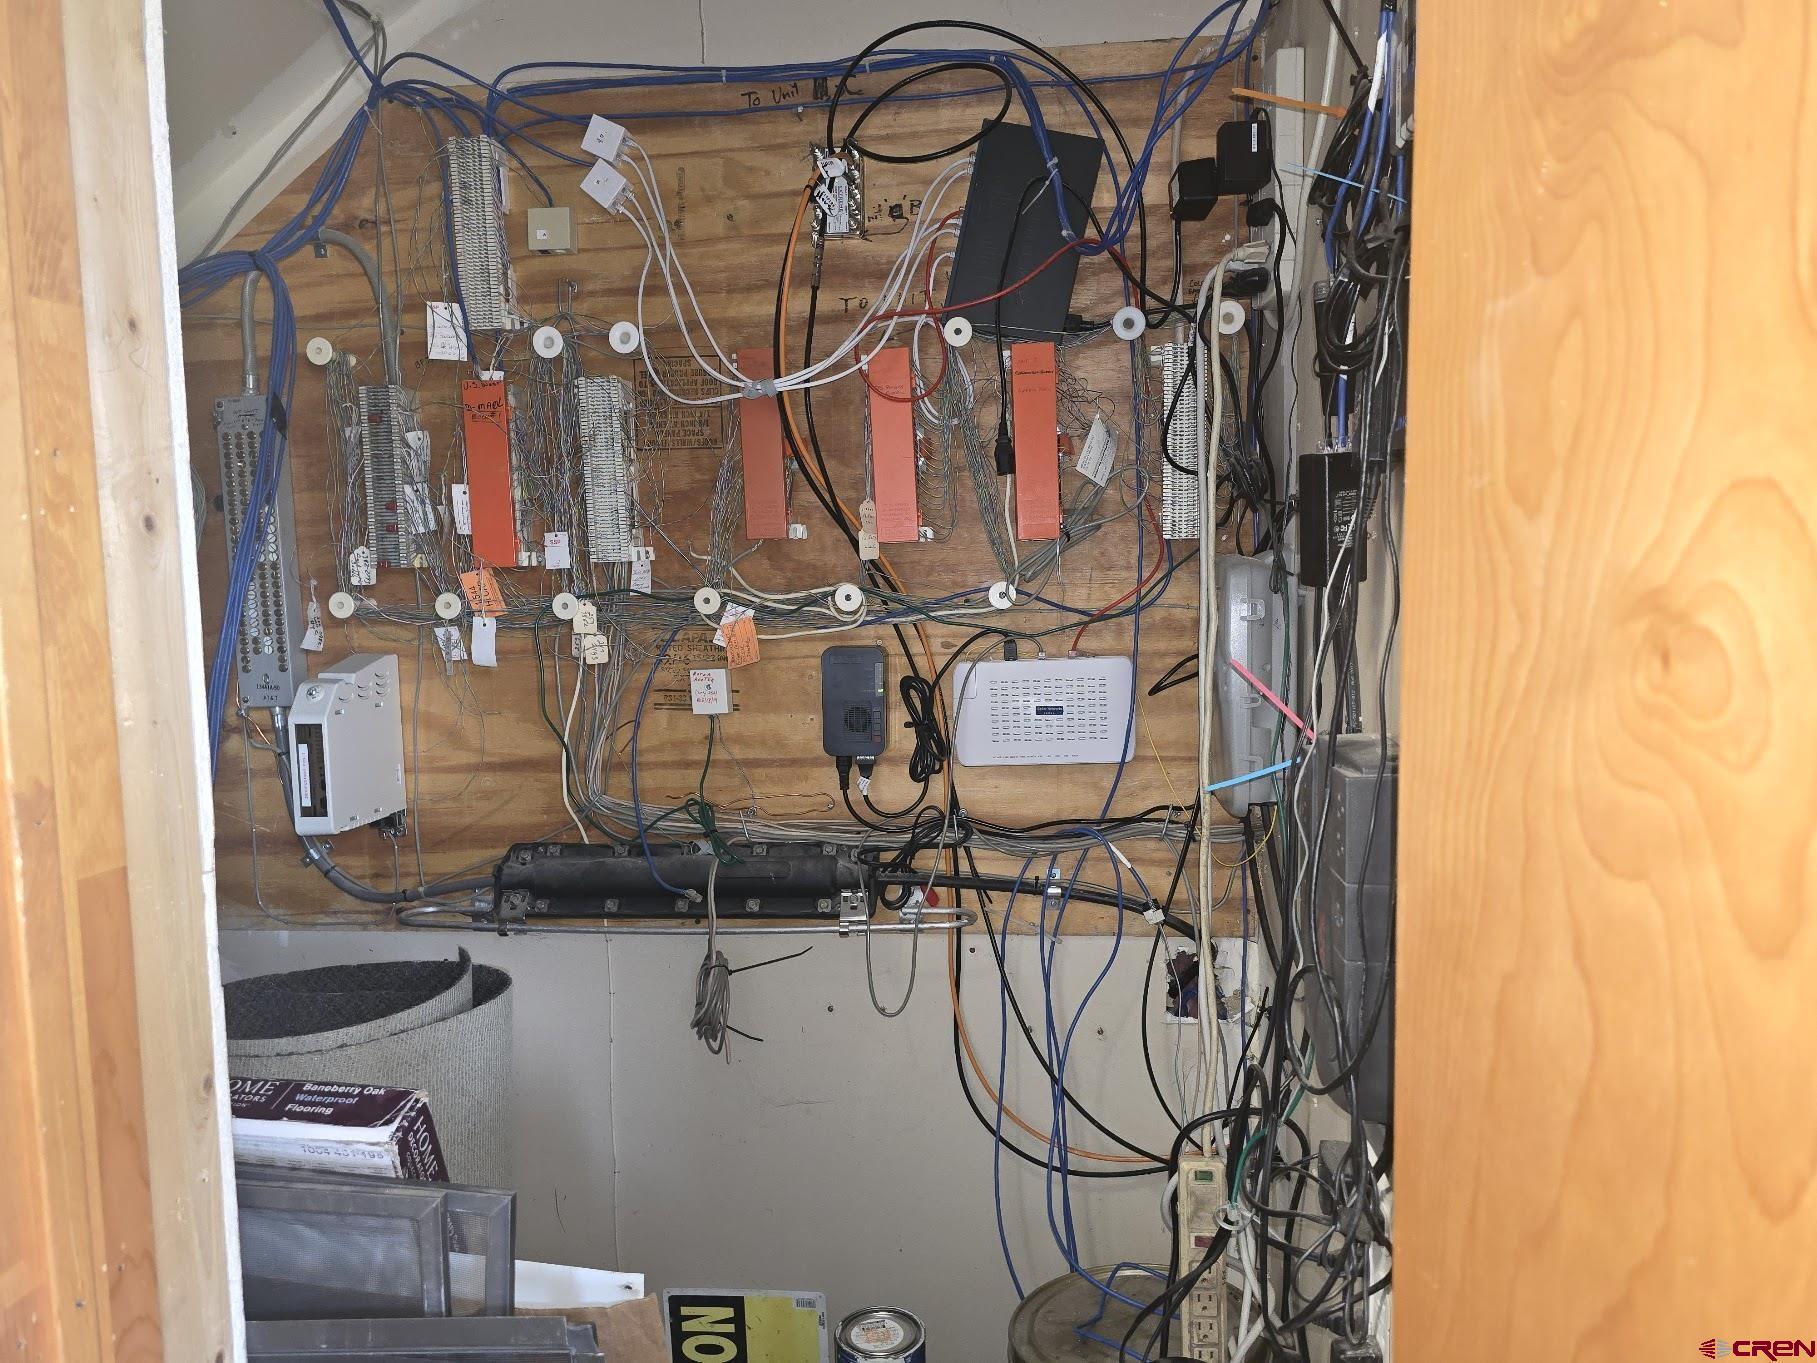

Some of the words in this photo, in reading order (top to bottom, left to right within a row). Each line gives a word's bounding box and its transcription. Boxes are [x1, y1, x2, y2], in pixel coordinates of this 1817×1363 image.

[741, 91, 760, 108] To
[772, 81, 799, 104] Unit
[838, 296, 868, 313] TO
[303, 1083, 361, 1095] Baneberry
[363, 1087, 386, 1095] Oak
[295, 1093, 359, 1104] Waterproof
[285, 1103, 334, 1115] Flooring
[413, 1115, 438, 1181] HOME
